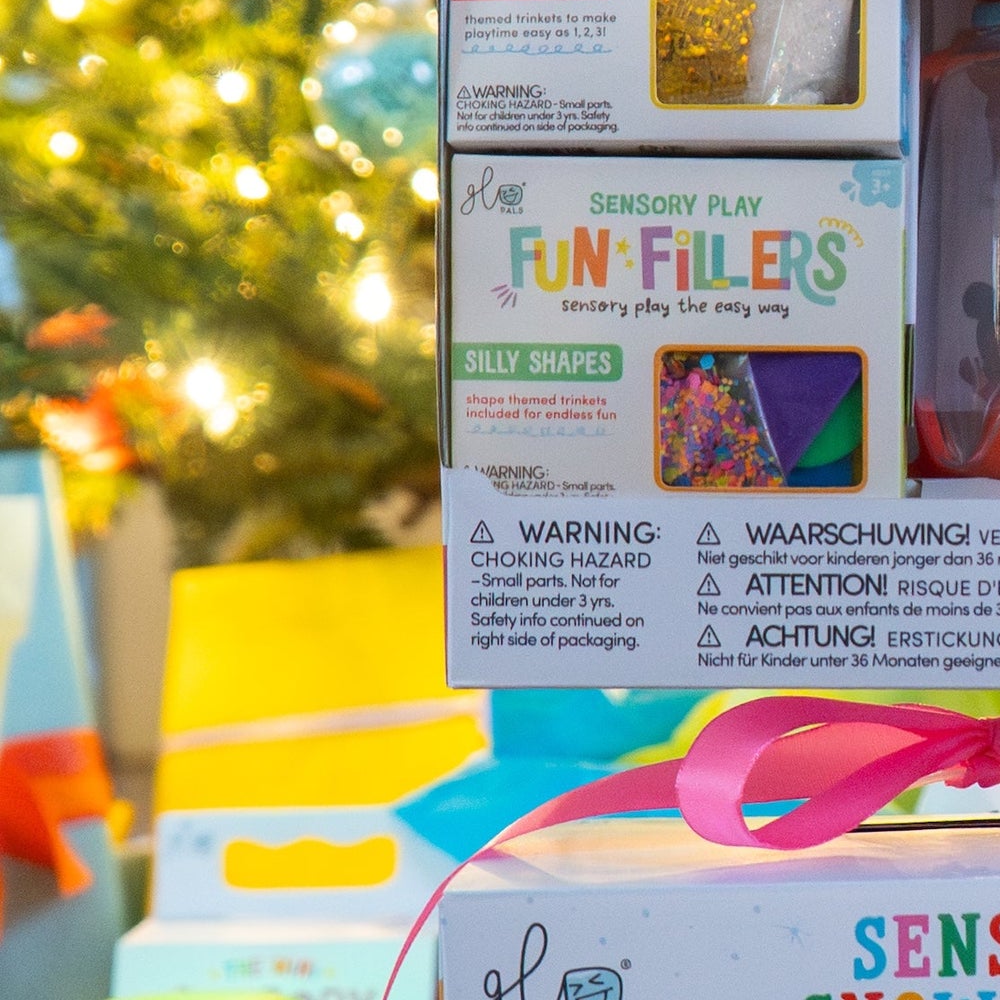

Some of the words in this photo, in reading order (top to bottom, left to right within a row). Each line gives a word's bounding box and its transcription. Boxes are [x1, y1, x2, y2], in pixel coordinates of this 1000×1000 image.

[464, 13, 512, 25] themed
[516, 12, 562, 24] trinkets
[567, 13, 579, 23] to
[583, 13, 617, 23] make
[464, 27, 518, 41] playtime
[523, 29, 551, 40] easy
[555, 29, 570, 37] as
[472, 84, 547, 99] WARNING:
[456, 100, 506, 110] CHOKING
[587, 100, 613, 113] parts.
[456, 111, 473, 120] Not
[475, 111, 486, 120] for
[489, 111, 526, 120] children
[528, 111, 555, 120] under
[556, 111, 562, 120] 3
[581, 111, 610, 123] Safety
[456, 122, 474, 132] info
[475, 122, 521, 132] continued
[522, 124, 535, 132] on
[536, 122, 554, 132] side
[557, 122, 567, 132] of
[568, 122, 619, 134] packaging.
[589, 192, 698, 217] SENSORY
[707, 194, 763, 218] PLAY
[509, 225, 611, 293] FUN
[561, 298, 628, 318] sensory
[634, 297, 670, 319] play
[678, 297, 708, 314] the
[714, 300, 752, 318] easy
[758, 301, 790, 318] way
[464, 349, 520, 374] SILLY
[528, 350, 612, 375] SHAPES
[466, 394, 504, 407] shape
[508, 394, 556, 406] themed
[560, 394, 607, 406] trinkets
[466, 408, 520, 419] included
[524, 408, 540, 419] for
[545, 408, 593, 419] endless
[596, 409, 617, 420] fun
[590, 481, 616, 492] parts.
[518, 519, 661, 544] WARNING:
[745, 522, 970, 546] WAARSCHUWING!
[470, 551, 565, 568] CHOKING
[570, 551, 652, 568] HAZARD
[697, 551, 725, 565] Niet
[728, 551, 788, 569] geschikt
[790, 554, 824, 566] voor
[826, 551, 889, 566] kinderen
[891, 552, 941, 569] jonger
[943, 552, 973, 566] dan
[976, 552, 994, 566] 36
[526, 573, 567, 591] parts.
[571, 574, 597, 588] Not
[599, 573, 620, 588] for
[745, 573, 888, 597] ATTENTION!
[898, 580, 971, 598] RISQUE
[470, 593, 528, 608] children
[532, 593, 576, 608] under
[578, 594, 587, 608] 3
[590, 597, 615, 612] yrs.
[697, 602, 718, 616] Ne
[721, 602, 783, 616] convient
[784, 604, 814, 619] pas
[816, 604, 842, 616] aux
[845, 602, 900, 616] enfants
[903, 602, 922, 616] de
[925, 603, 970, 617] moins
[973, 603, 993, 617] de
[470, 612, 517, 630] Safety
[519, 612, 547, 627] info
[550, 613, 622, 627] continued
[625, 616, 644, 627] on
[470, 632, 504, 650] right
[507, 632, 537, 647] side
[540, 632, 556, 647] of
[558, 633, 640, 651] packaging.
[745, 624, 876, 648] ACHTUNG!
[697, 653, 735, 667] Nicht
[737, 653, 758, 667] für
[761, 653, 807, 668] Kinder
[810, 655, 849, 668] unter
[851, 654, 869, 667] 36
[872, 653, 940, 668] Monaten
